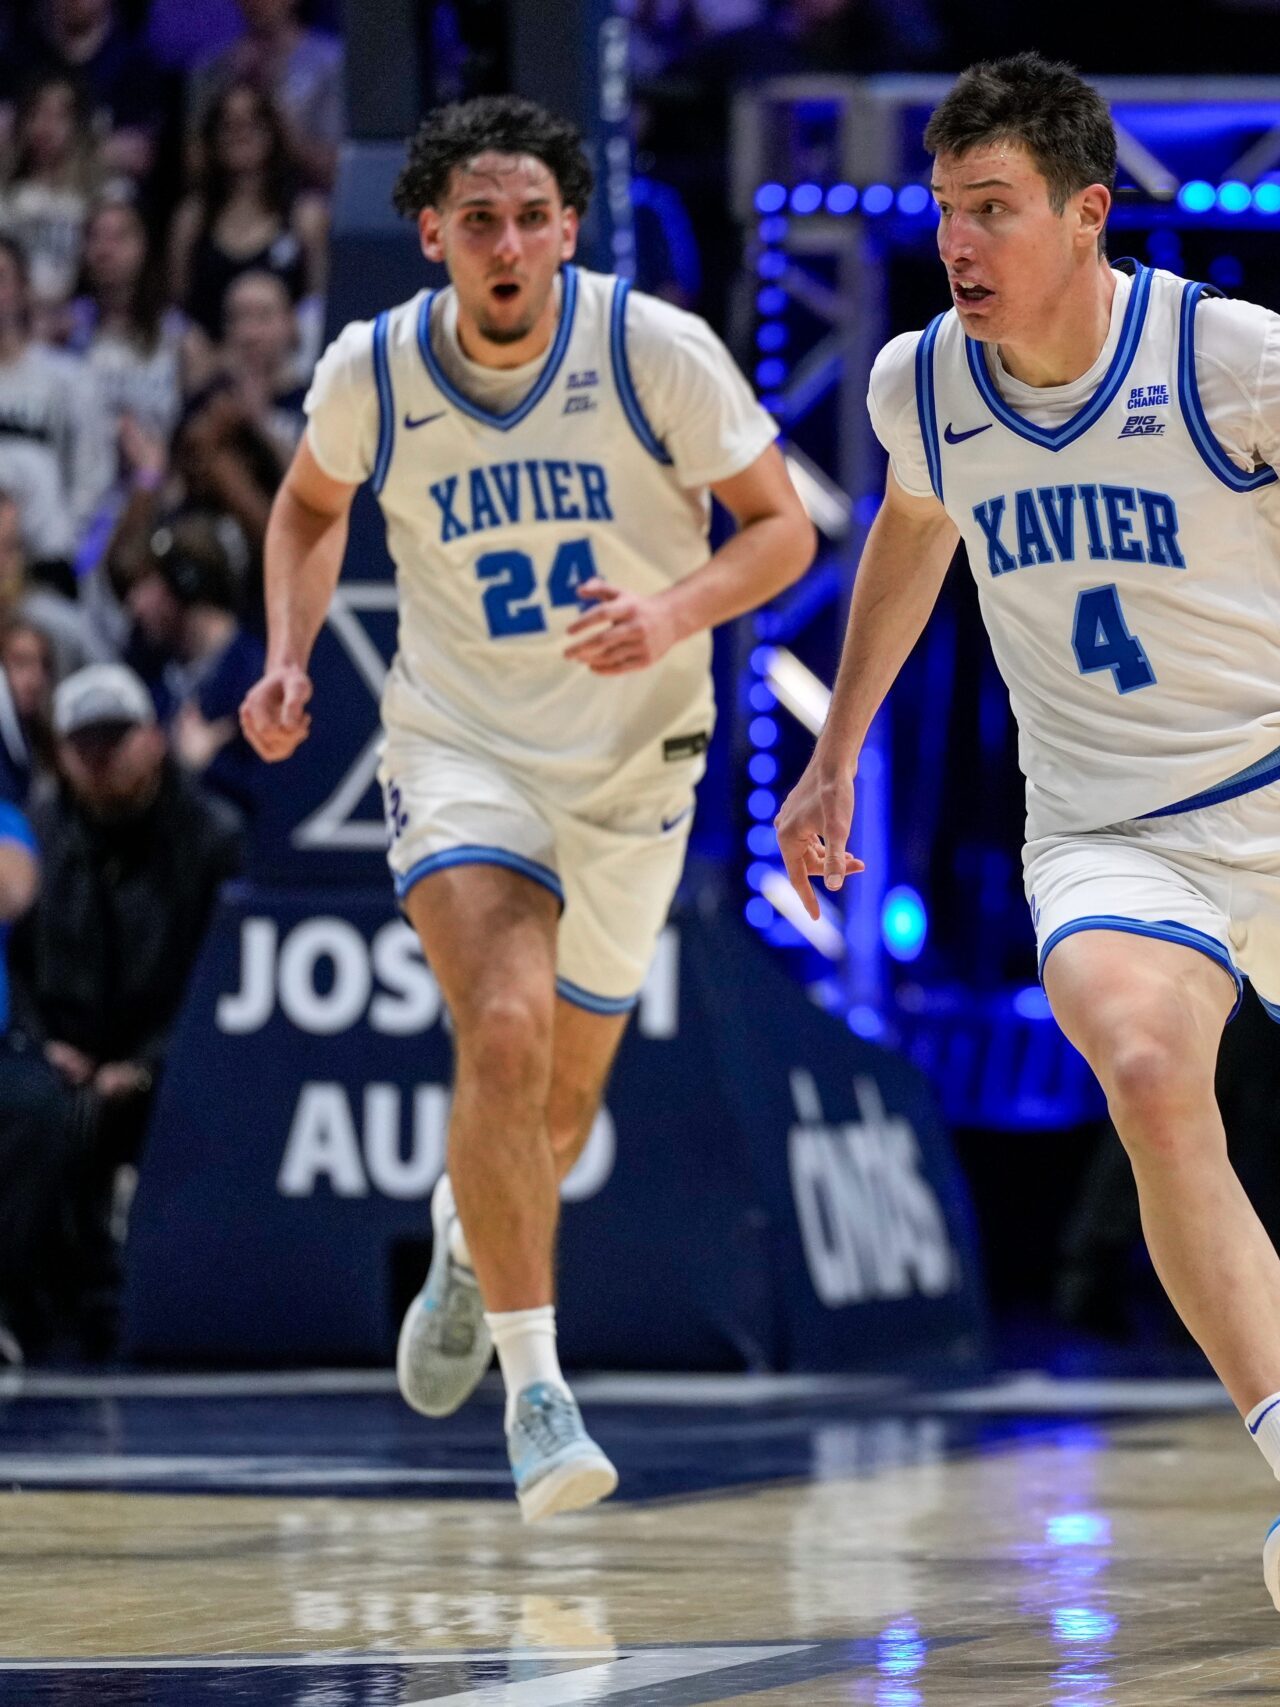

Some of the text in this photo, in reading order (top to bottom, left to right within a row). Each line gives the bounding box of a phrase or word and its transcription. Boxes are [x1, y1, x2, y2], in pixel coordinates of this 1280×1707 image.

[1127, 394, 1169, 410] CHANGE
[1130, 384, 1167, 399] BE THE
[1121, 424, 1165, 434] EAST
[1125, 415, 1157, 426] BIG
[430, 459, 614, 543] XAVIER
[972, 484, 1187, 578] XAVIER
[475, 538, 607, 640] 24
[1071, 583, 1157, 695] 4
